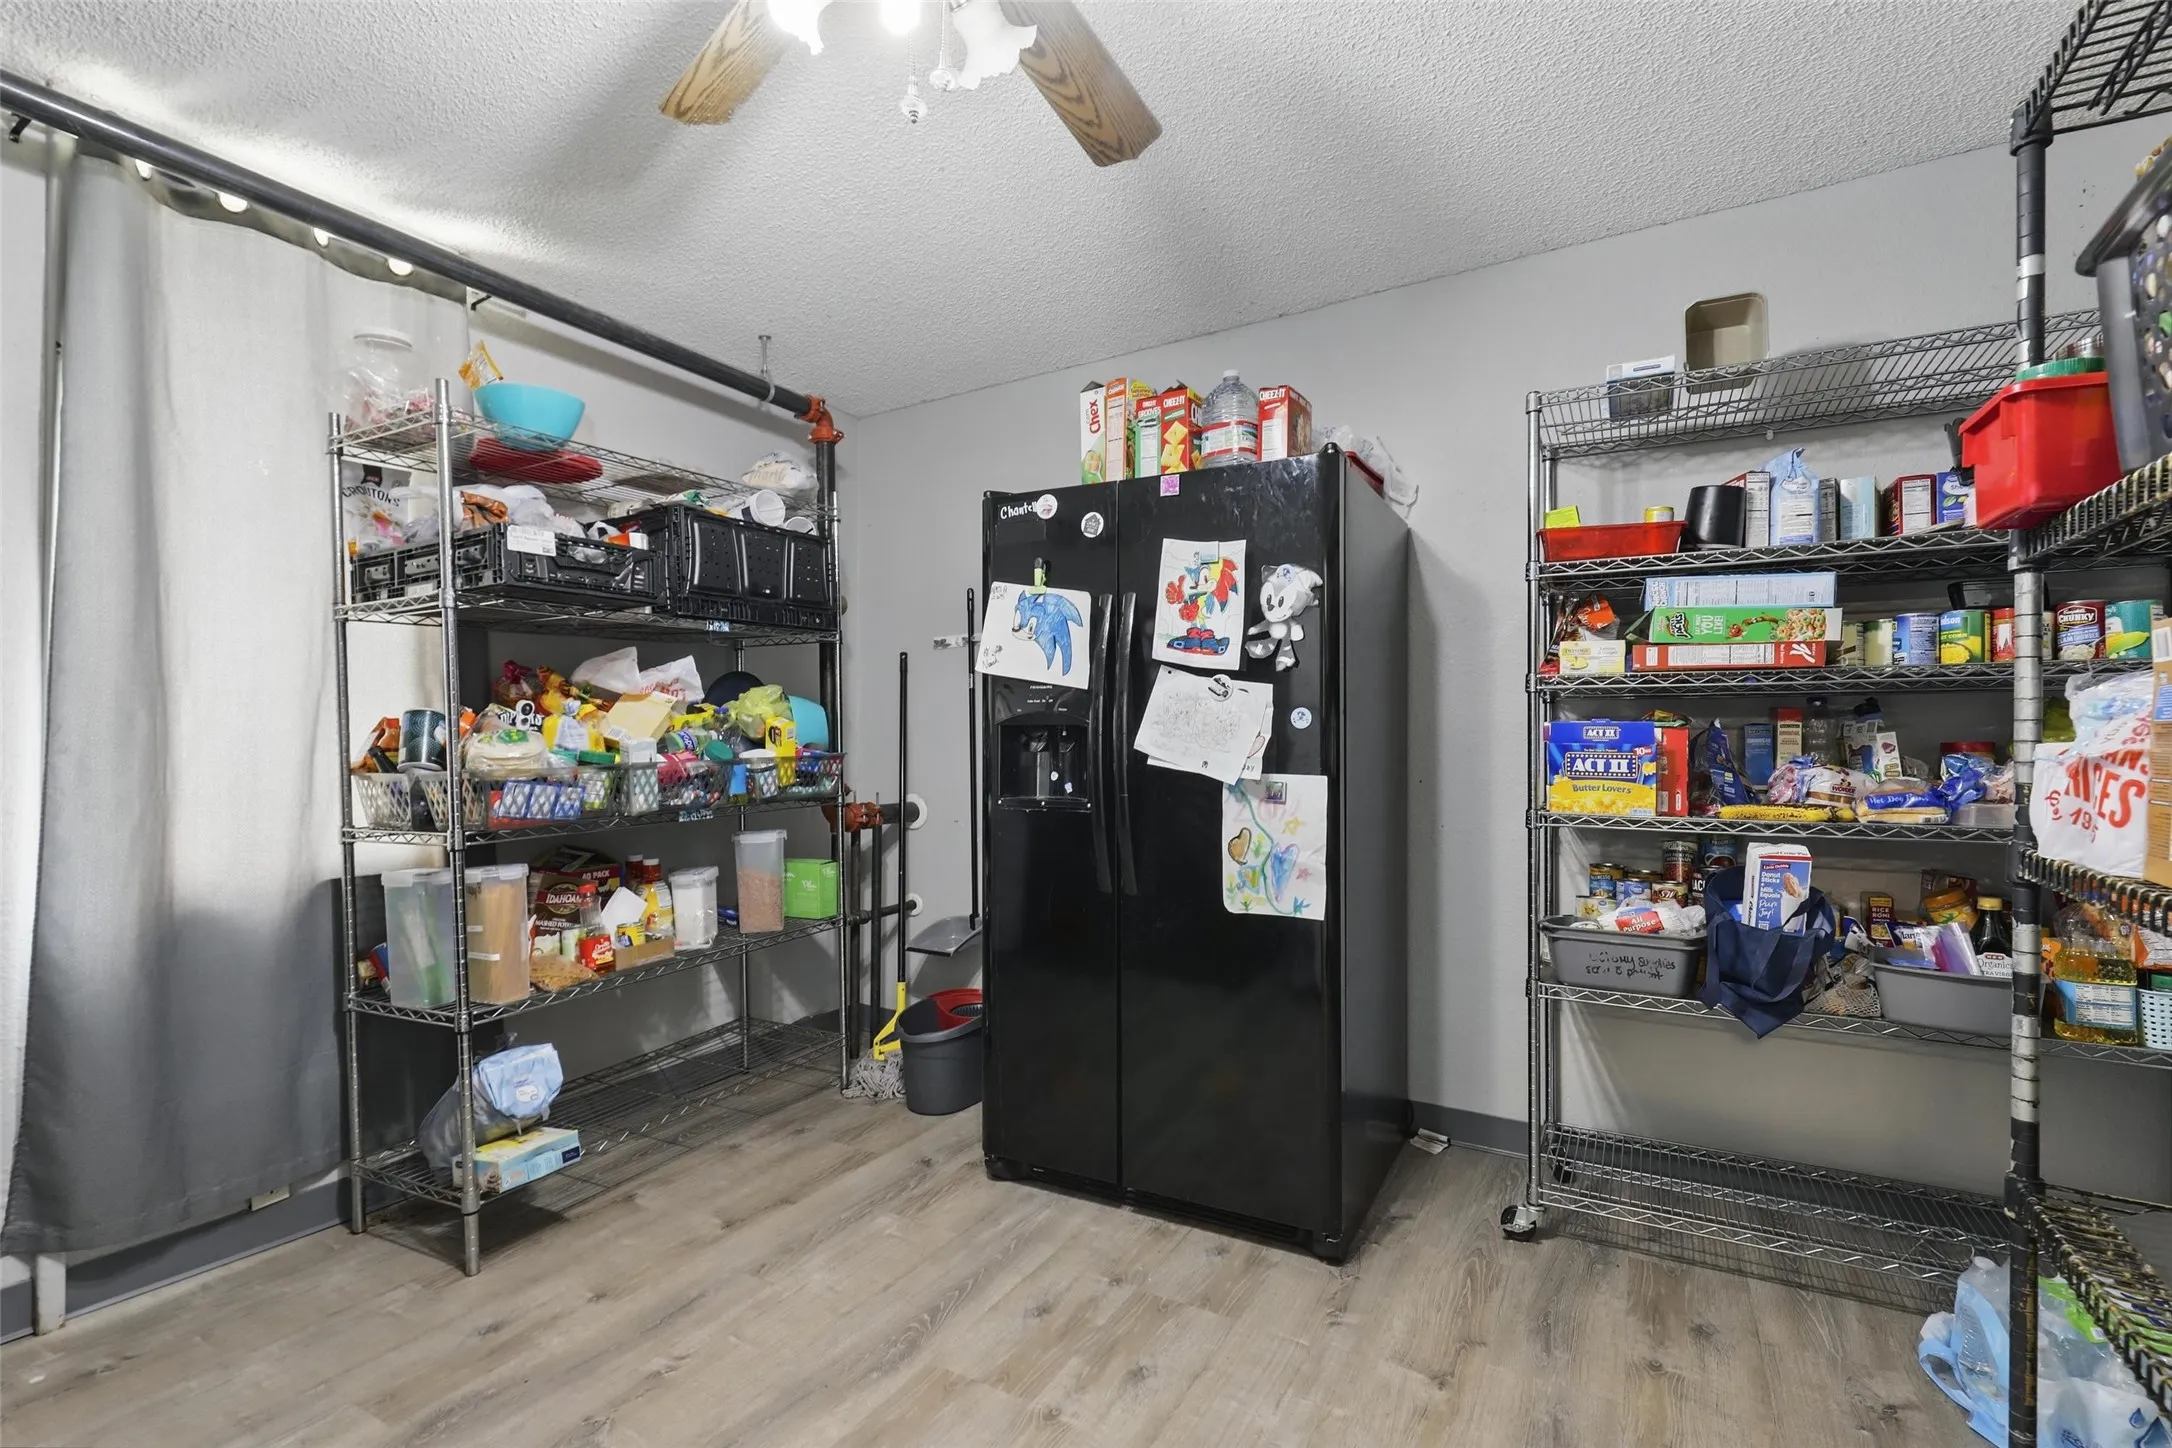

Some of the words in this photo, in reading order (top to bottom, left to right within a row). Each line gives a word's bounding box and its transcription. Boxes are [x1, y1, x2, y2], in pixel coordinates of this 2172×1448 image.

[1260, 388, 1286, 400] CHEEZ-IT
[1163, 396, 1186, 408] CHEEZ-IT
[1089, 400, 1101, 434] Chex
[342, 484, 400, 508] CROUTONS
[2059, 612, 2095, 623] CHUNKY
[1674, 612, 1688, 638] JACKS
[1701, 615, 1713, 635] YOU
[1634, 747, 1645, 755] 10
[1572, 758, 1609, 772] ACT
[1610, 759, 1630, 772] II
[1572, 784, 1601, 793] Butter
[1602, 784, 1632, 794] Lovers
[1831, 785, 1857, 794] WONDER
[1869, 796, 1886, 804] Hot
[1889, 795, 1904, 805] Dog
[593, 870, 610, 878] PACK
[1759, 908, 1774, 918] Joy!
[1623, 919, 1656, 932] Purpose
[1631, 916, 1643, 924] All
